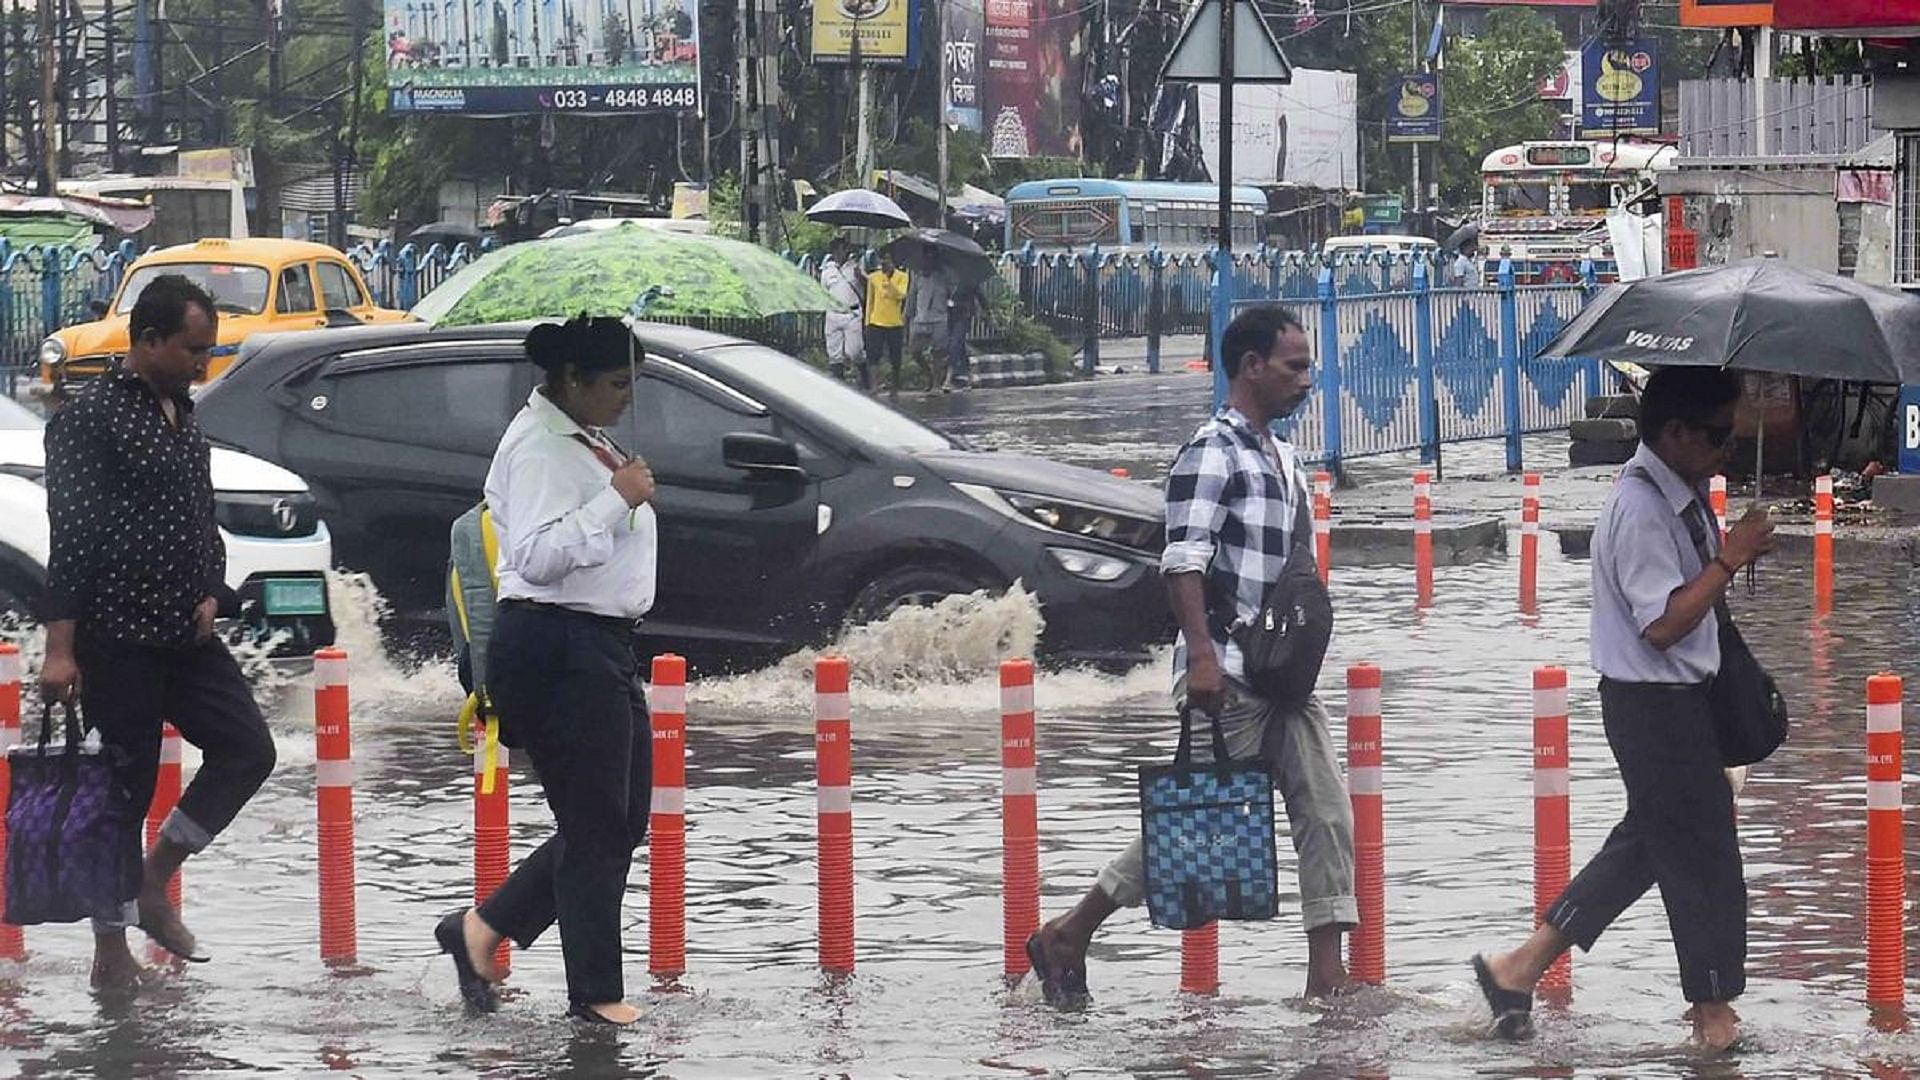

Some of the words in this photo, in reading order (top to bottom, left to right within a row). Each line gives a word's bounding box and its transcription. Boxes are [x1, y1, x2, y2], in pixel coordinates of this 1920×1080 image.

[413, 89, 465, 99] MAGNOLIA
[554, 90, 587, 108] 033
[605, 89, 649, 107] 4848
[652, 88, 695, 107] 4848
